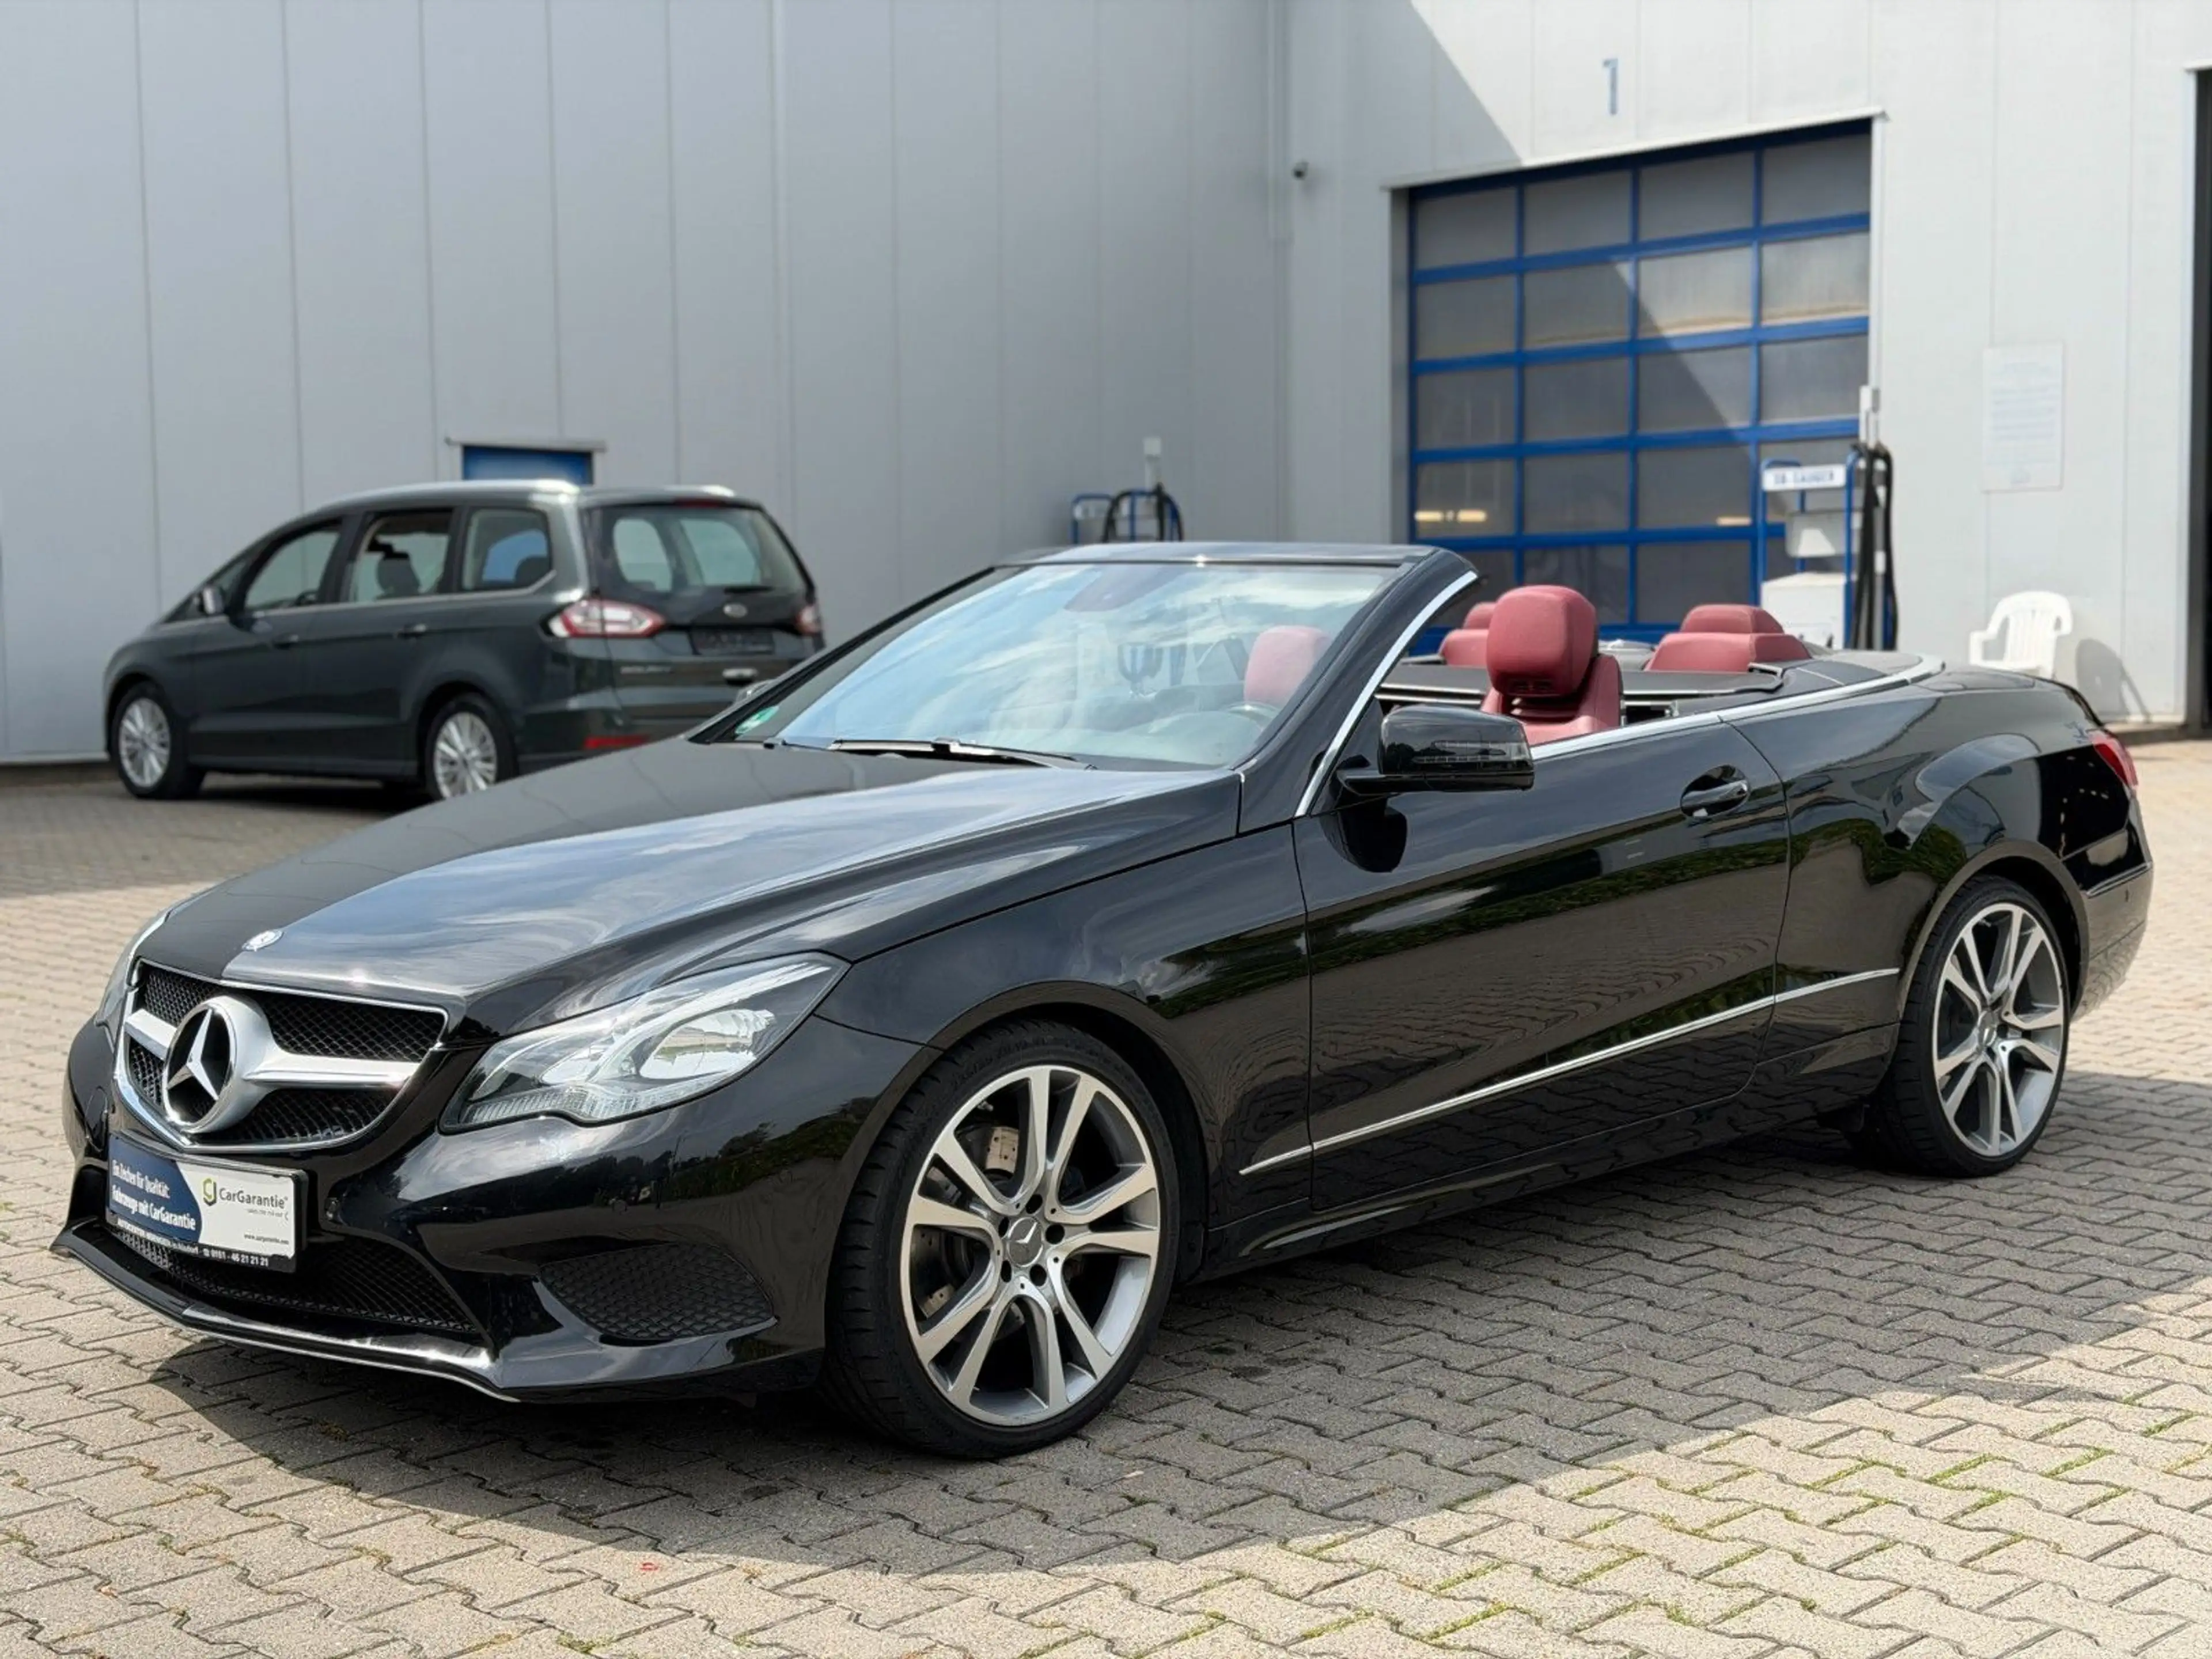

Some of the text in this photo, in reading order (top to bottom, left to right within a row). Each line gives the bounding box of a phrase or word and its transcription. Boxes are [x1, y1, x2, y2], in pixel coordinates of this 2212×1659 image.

[1603, 58, 1618, 115] 1
[149, 1203, 196, 1232] CarGarantie
[241, 1253, 249, 1263] 21
[250, 1255, 259, 1265] 21
[260, 1256, 269, 1267] 21
